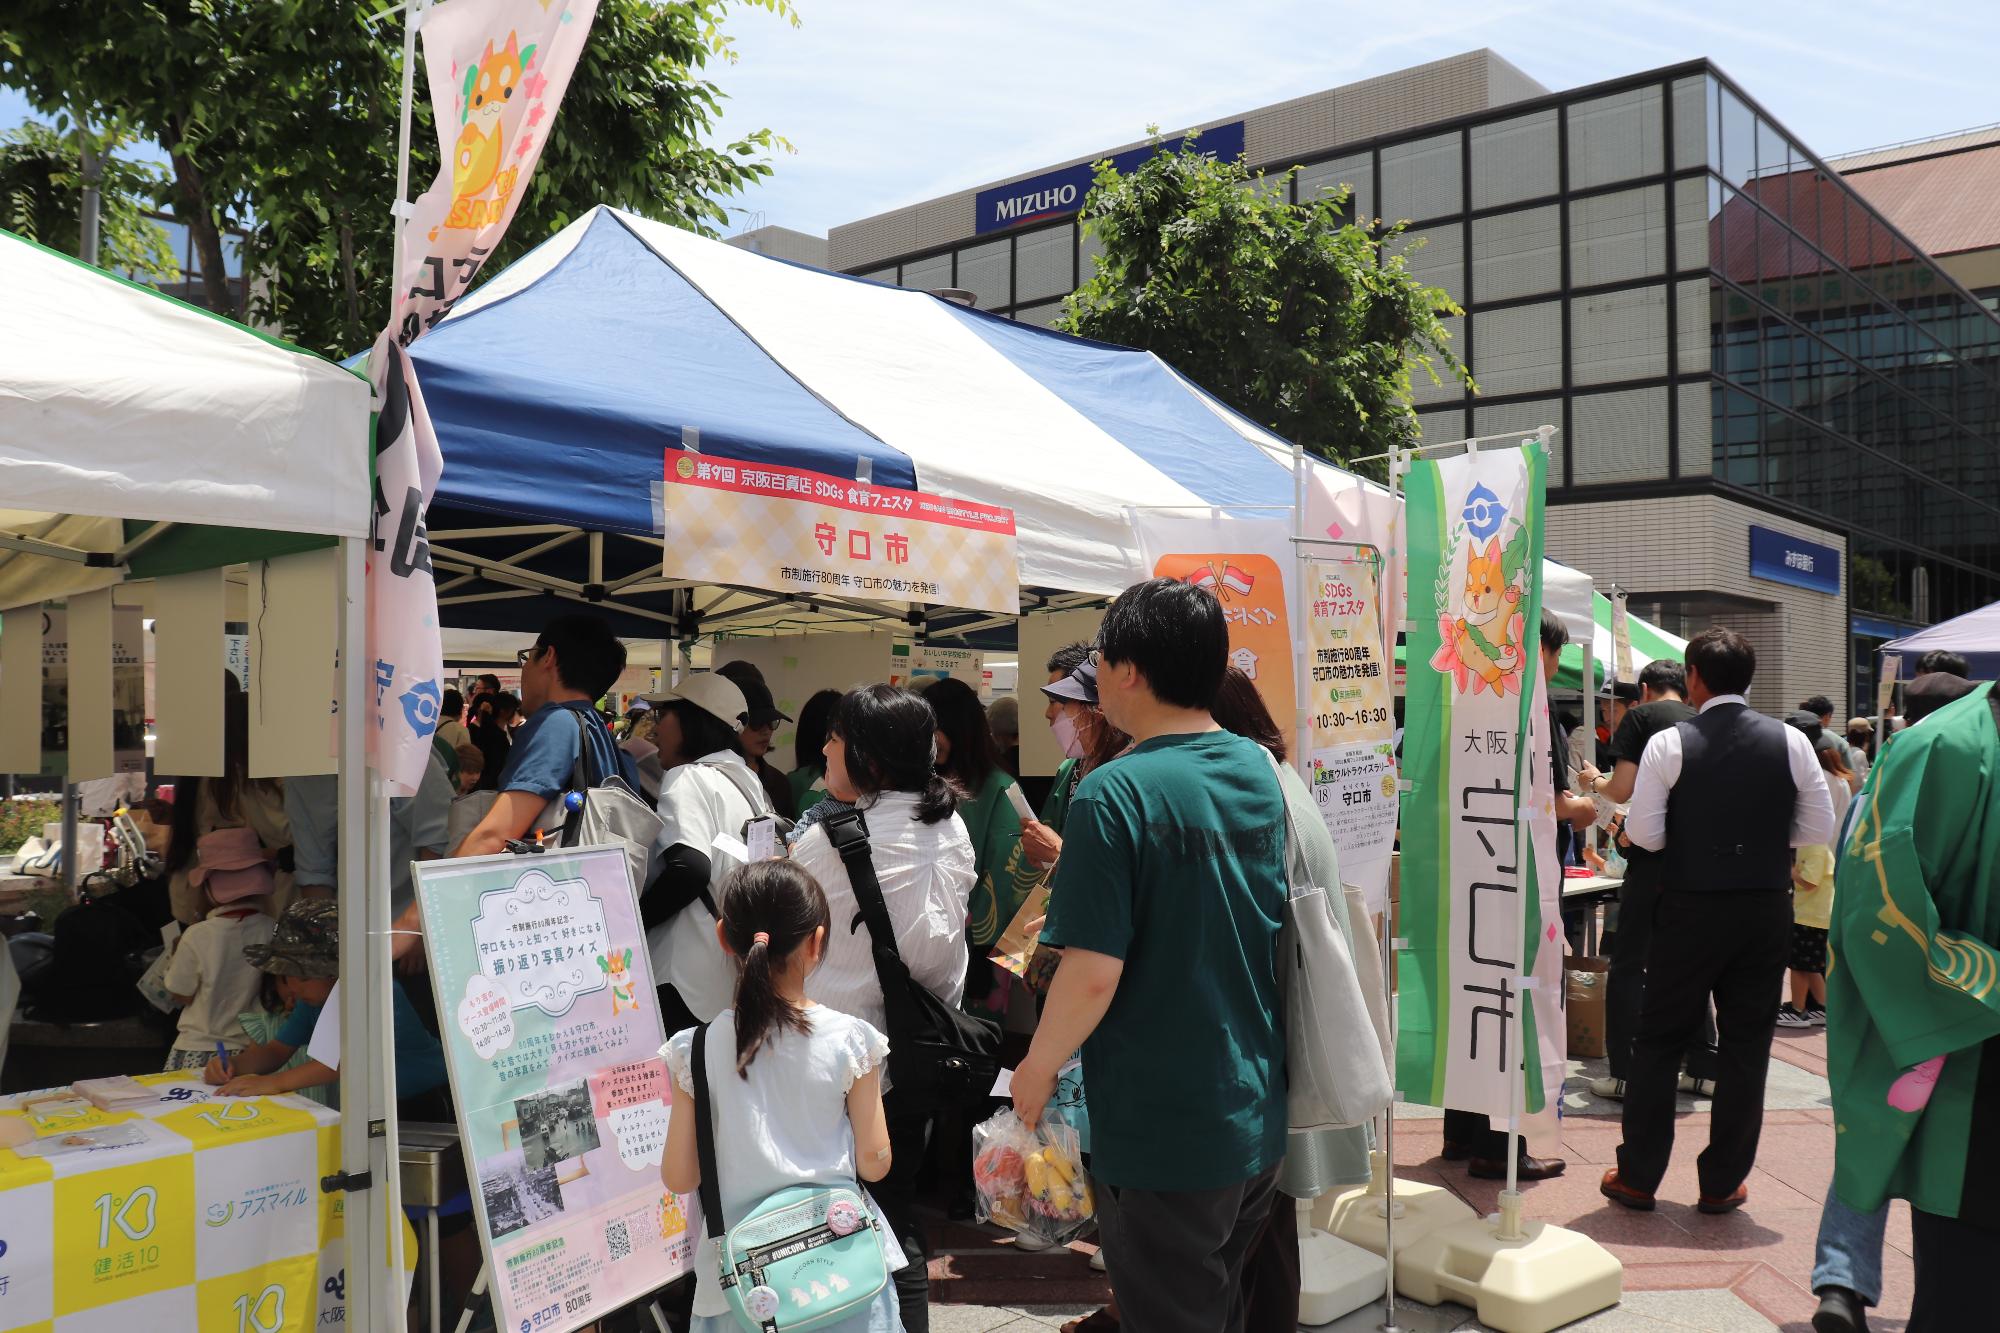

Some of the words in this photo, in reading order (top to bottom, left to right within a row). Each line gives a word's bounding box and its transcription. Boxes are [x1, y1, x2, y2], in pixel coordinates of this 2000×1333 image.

[996, 184, 1077, 222] MIZUHO
[697, 462, 736, 484] 第9回
[740, 469, 812, 495] 京阪百貨店
[815, 480, 844, 501] SDGs
[847, 487, 913, 512] 食育フェスタ
[814, 522, 909, 565] 守口市
[780, 566, 851, 587] 市制施行80周年
[1325, 582, 1353, 598] SDGs
[1313, 599, 1365, 618] 食育フェスタ
[1330, 629, 1348, 639] 守口市
[1317, 646, 1371, 664] 市制施行80周年
[1320, 762, 1390, 781] 食育ウルトラクイズラリー
[1342, 782, 1371, 791] もりぐちし
[1318, 788, 1329, 803] 18
[1342, 789, 1372, 807] 守口市
[480, 932, 558, 955] 守口をもっと知って
[561, 922, 602, 939] 好きになる
[493, 940, 598, 976] 振り返り写真クイズ
[622, 1109, 652, 1121] タンブラー
[238, 1187, 307, 1219] アスマイル
[94, 1245, 160, 1276] 健活10
[532, 1303, 561, 1326] 守口市
[565, 1292, 593, 1314] 80周年
